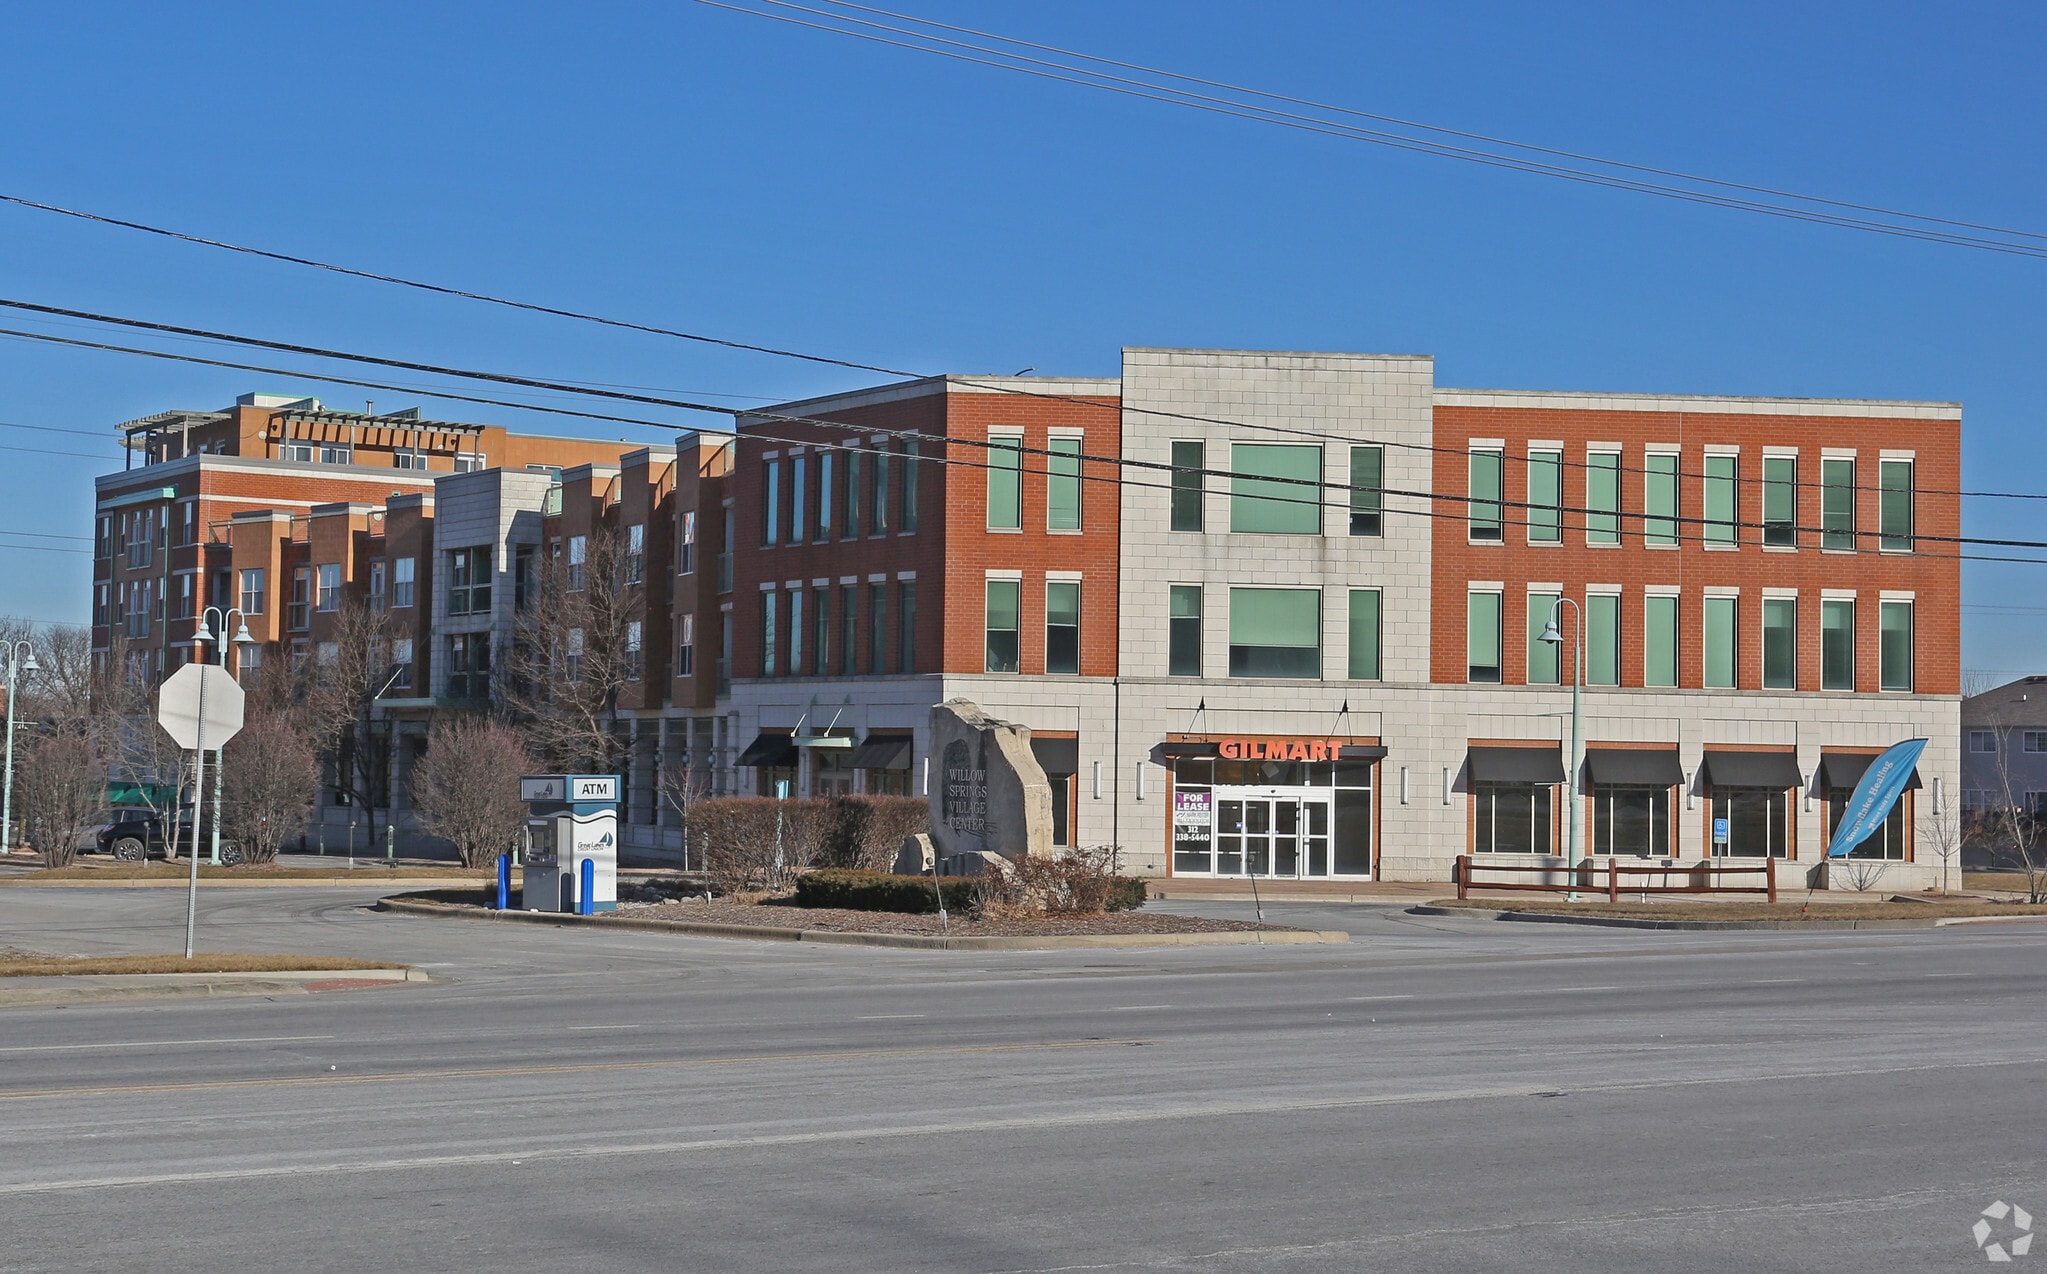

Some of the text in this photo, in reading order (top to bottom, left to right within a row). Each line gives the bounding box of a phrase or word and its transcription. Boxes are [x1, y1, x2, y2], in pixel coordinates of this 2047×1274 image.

[1219, 739, 1342, 761] GILMART
[949, 769, 985, 781] WILLOW
[1869, 761, 1893, 796] Healing
[582, 784, 607, 795] ATM
[949, 785, 987, 798] SPRINGS
[1183, 793, 1204, 802] FOR
[949, 801, 986, 814] VILLAGE
[1177, 802, 1210, 811] LEASE
[949, 817, 985, 830] CENTER
[1187, 825, 1199, 833] 312
[1175, 833, 1210, 841] 338-5440
